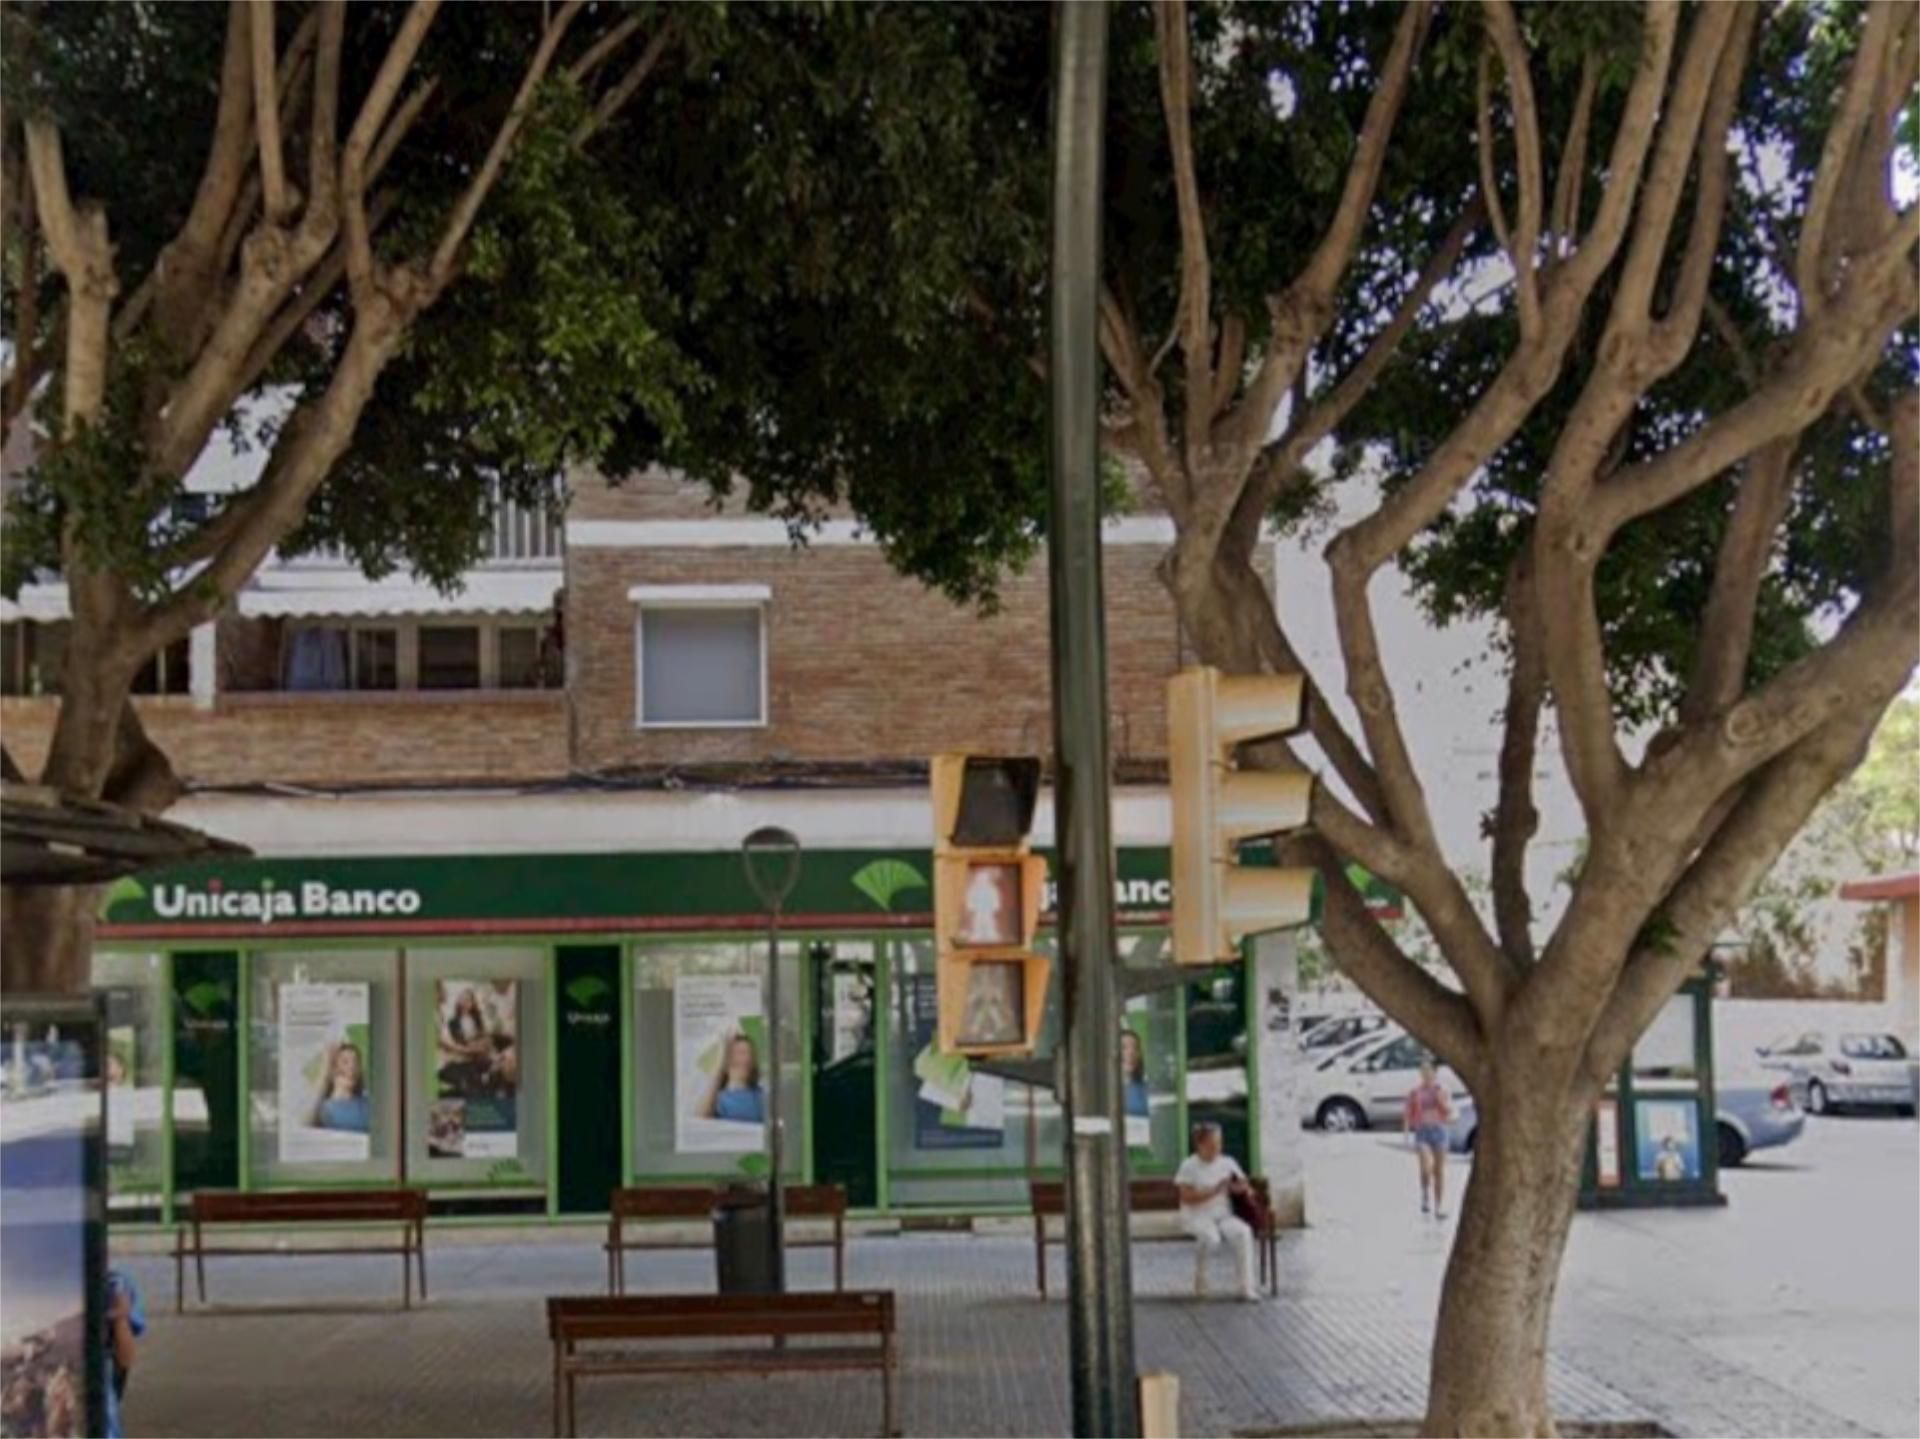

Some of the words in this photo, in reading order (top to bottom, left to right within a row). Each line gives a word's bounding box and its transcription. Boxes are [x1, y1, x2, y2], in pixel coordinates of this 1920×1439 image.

[153, 878, 296, 924] Unicaja
[302, 881, 421, 914] Banco
[1114, 879, 1171, 904] anc
